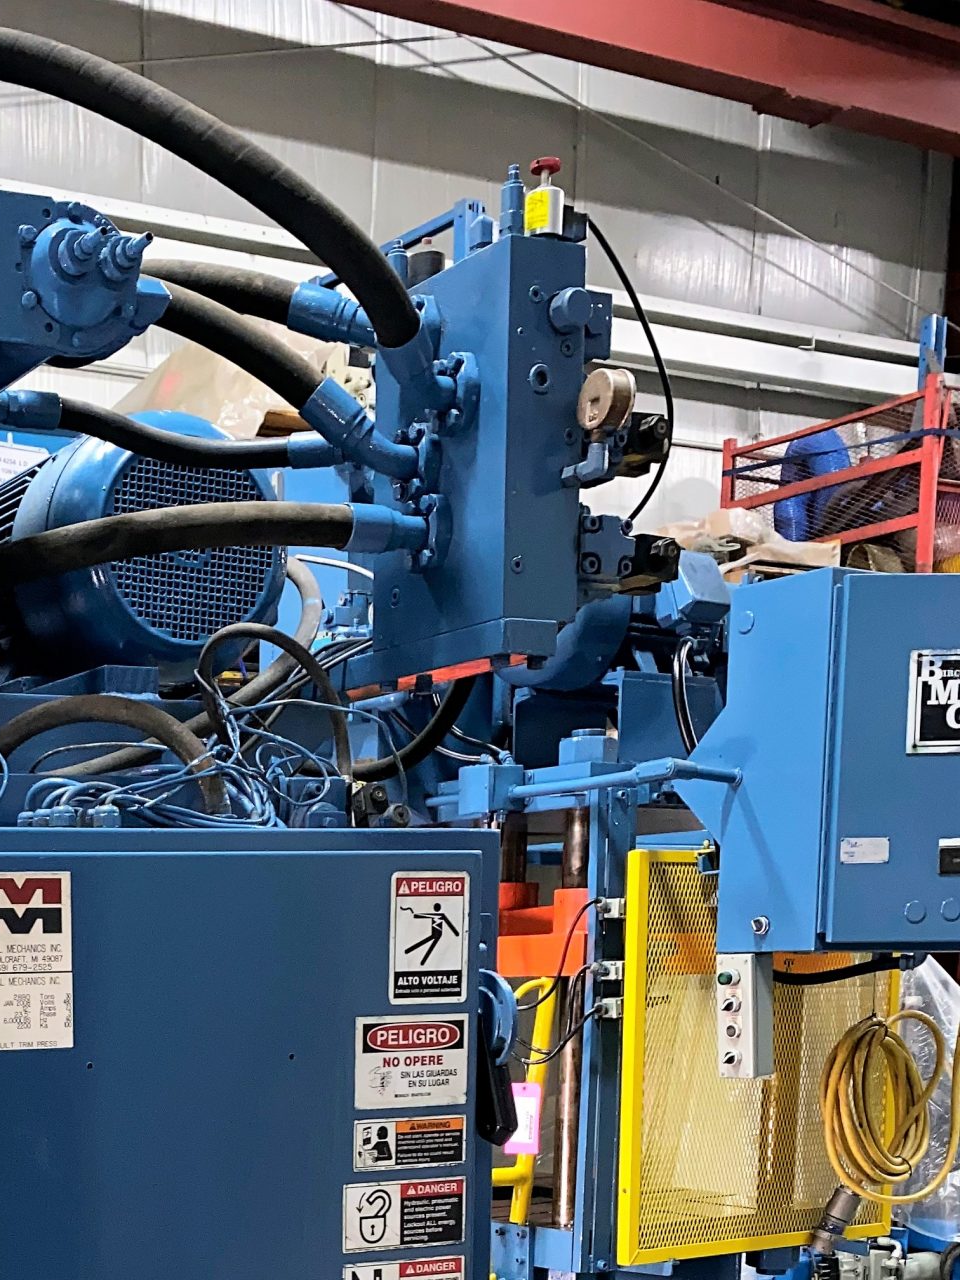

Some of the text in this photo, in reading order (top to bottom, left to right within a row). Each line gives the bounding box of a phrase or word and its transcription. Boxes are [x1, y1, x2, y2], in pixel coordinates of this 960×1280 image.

[411, 882, 462, 892] PELIGRO
[6, 944, 46, 953] MECHANICS
[8, 977, 46, 985] MECHANICS
[398, 976, 458, 985] ALTO VOLTAJE
[376, 1028, 450, 1046] PELIGRO
[383, 1055, 443, 1068] NO OPERE
[426, 1069, 457, 1077] GUARDAS
[416, 1121, 450, 1129] WARNING
[418, 1183, 458, 1194] DANGER
[416, 1261, 456, 1273] DANGER
